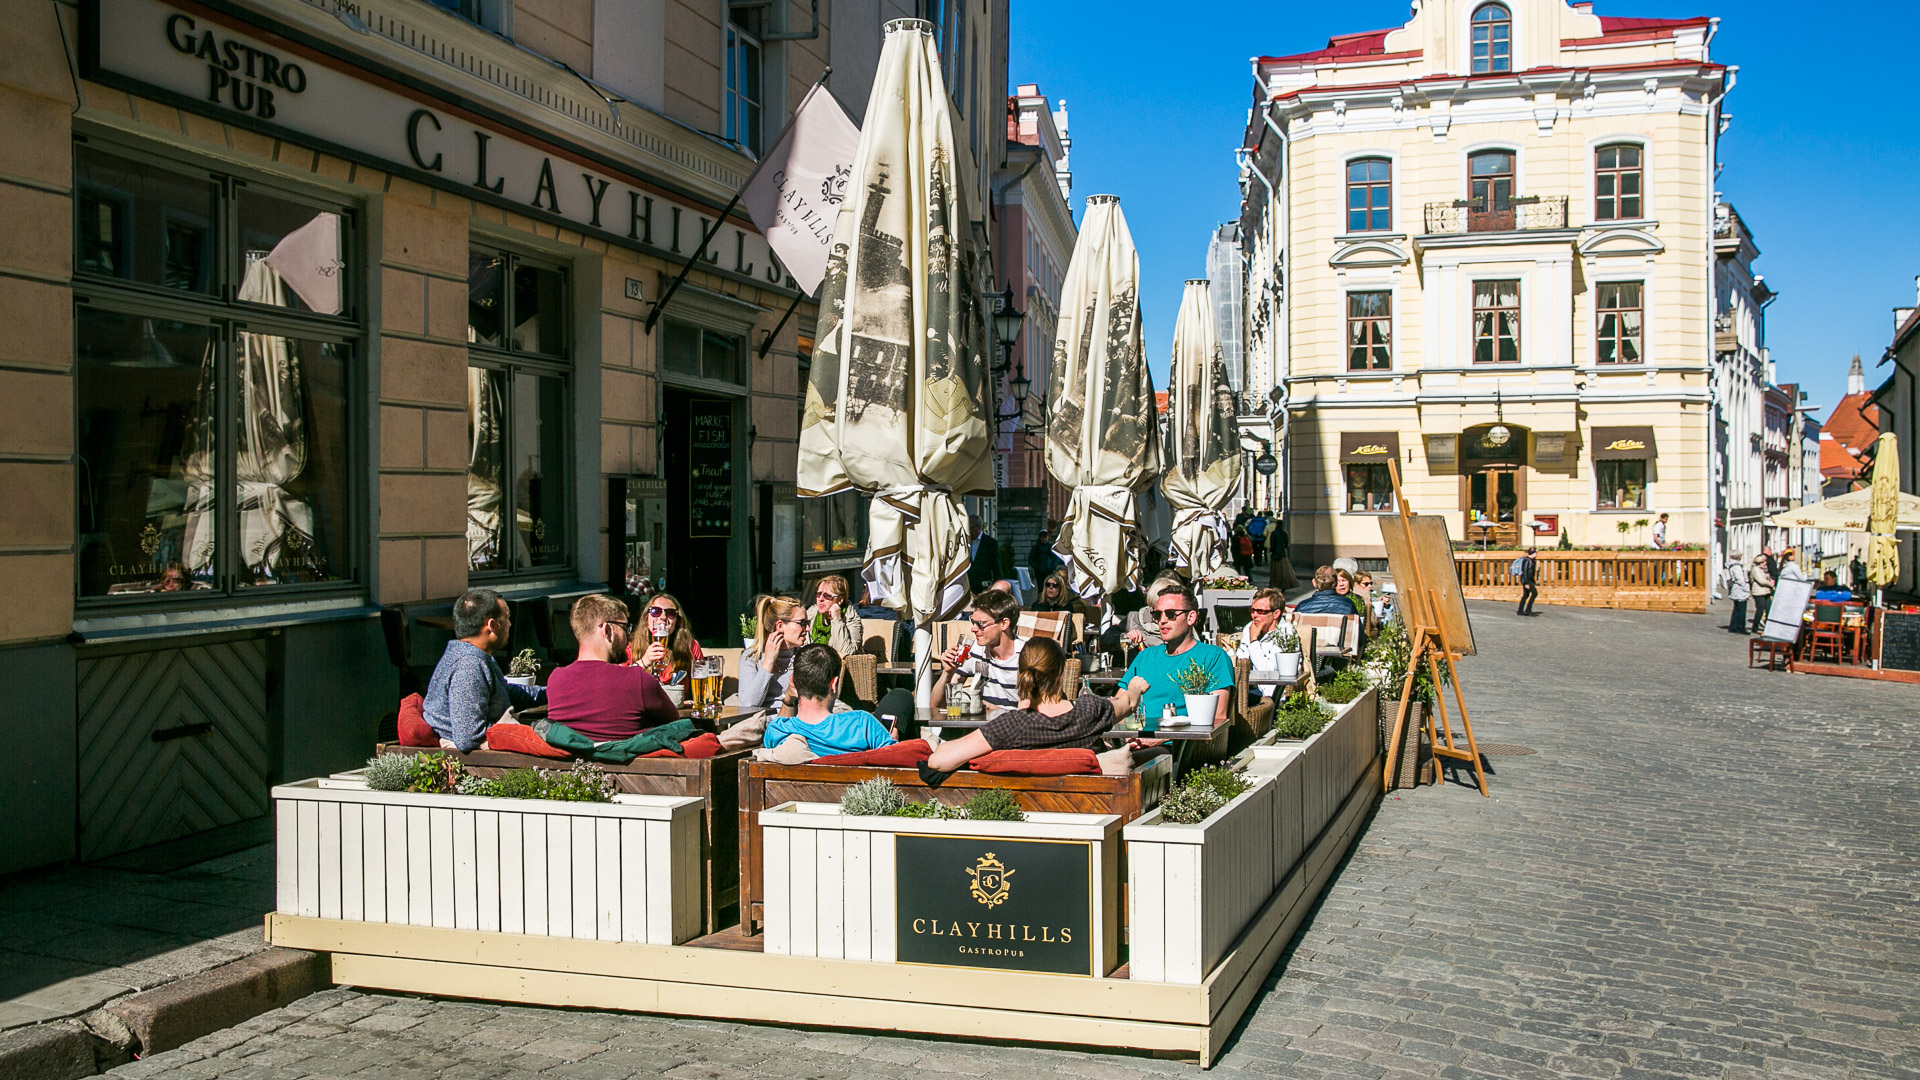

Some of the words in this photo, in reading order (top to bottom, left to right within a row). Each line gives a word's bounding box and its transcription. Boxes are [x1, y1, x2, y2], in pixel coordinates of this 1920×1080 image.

[166, 13, 307, 94] GASTRO
[208, 64, 277, 119] PUB
[406, 109, 782, 284] CLAYHILLS
[630, 282, 639, 297] 13
[695, 415, 730, 428] MARKET
[698, 429, 725, 443] FISH
[627, 480, 668, 489] CLAYHILLS
[1795, 518, 1816, 526] saku
[1843, 520, 1864, 529] saku
[912, 918, 1073, 944] CLAYHILLS
